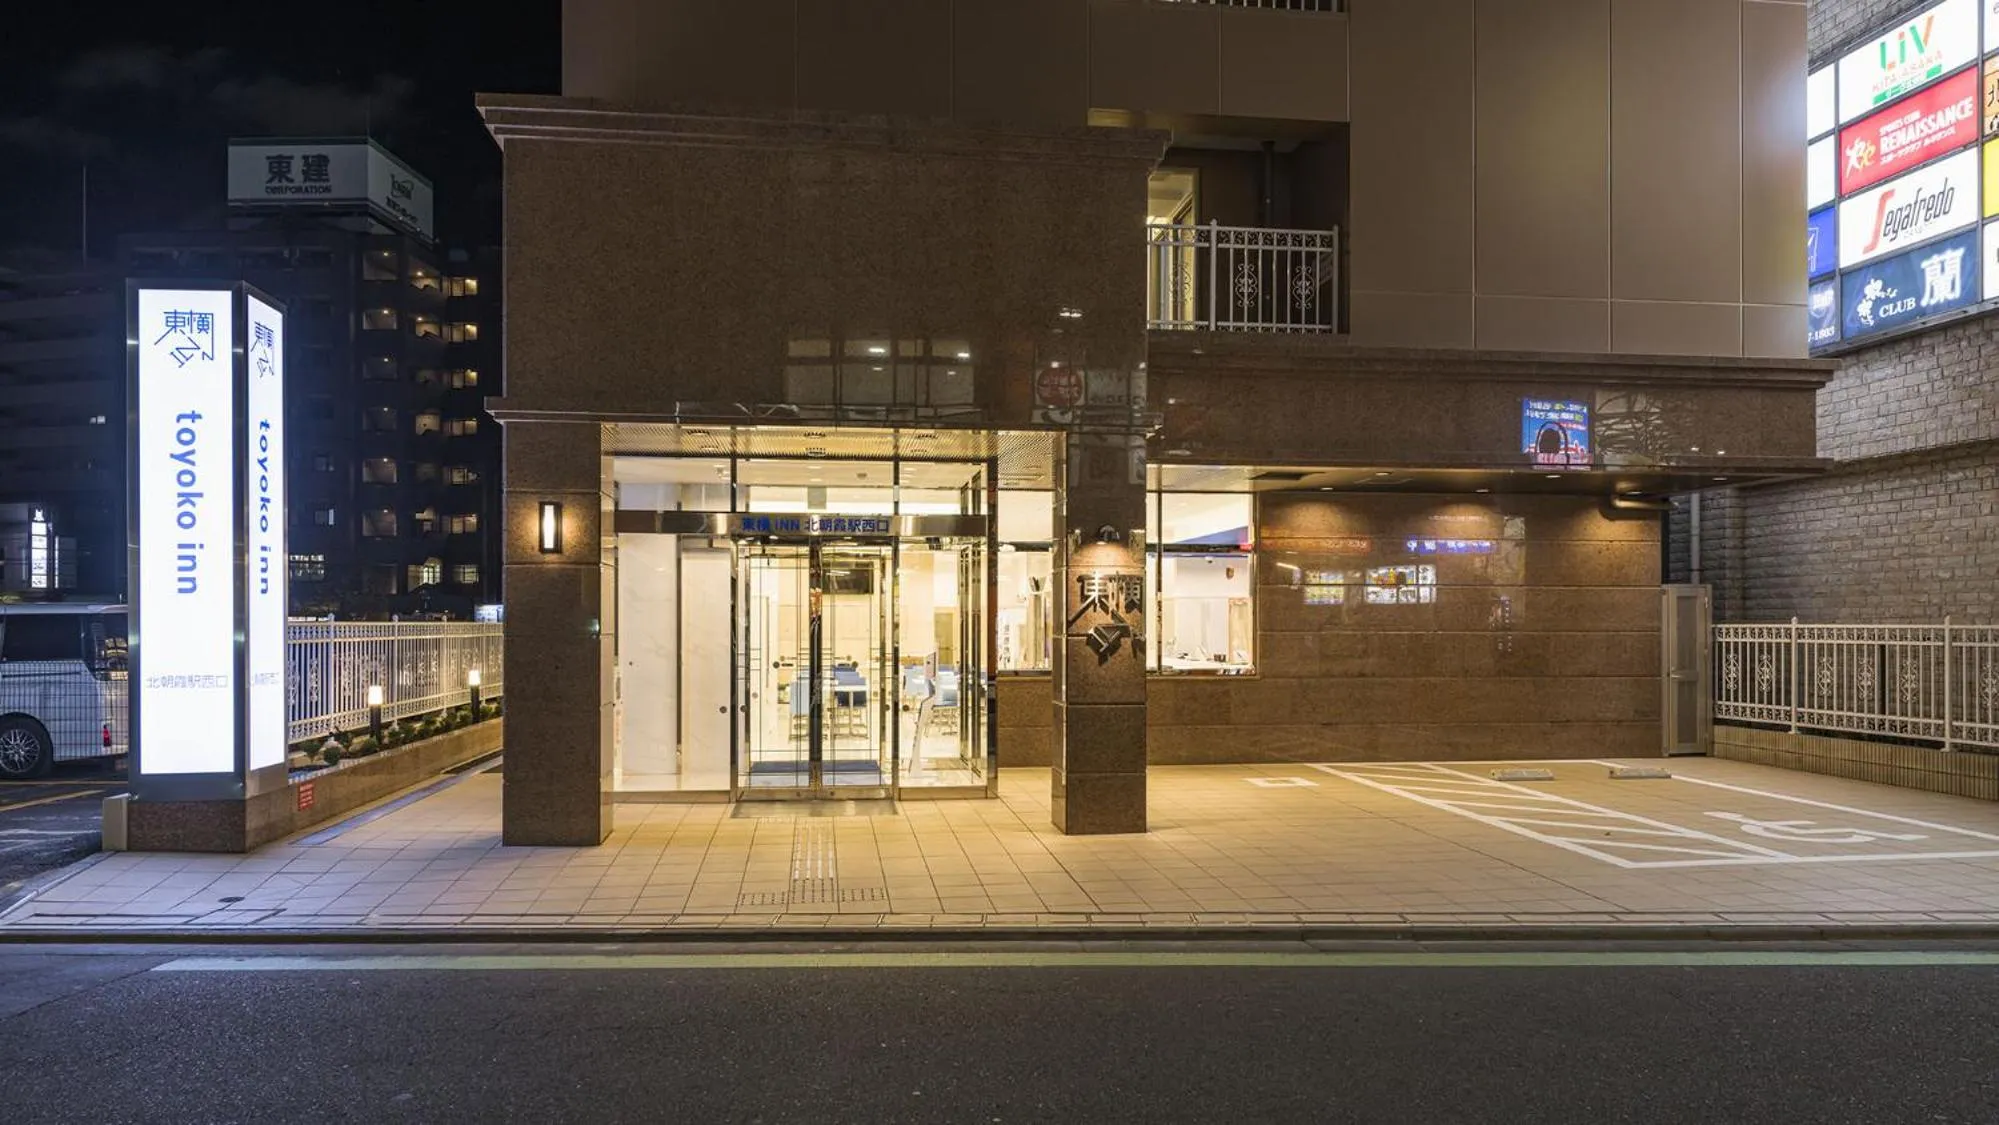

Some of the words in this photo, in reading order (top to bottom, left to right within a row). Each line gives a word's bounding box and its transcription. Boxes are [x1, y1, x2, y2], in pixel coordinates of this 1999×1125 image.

[1880, 96, 1974, 156] RENAISSANCE
[265, 153, 331, 184] 東建
[1862, 177, 1955, 254] Segafredo
[1920, 246, 1966, 308] 蘭
[1879, 298, 1916, 319] CLUB
[170, 410, 204, 530] toyoko
[257, 419, 271, 533] toyoko
[775, 517, 800, 532] INN
[804, 516, 889, 533] 北朝霞駅西口
[177, 543, 205, 594] inn
[260, 545, 271, 595] inn
